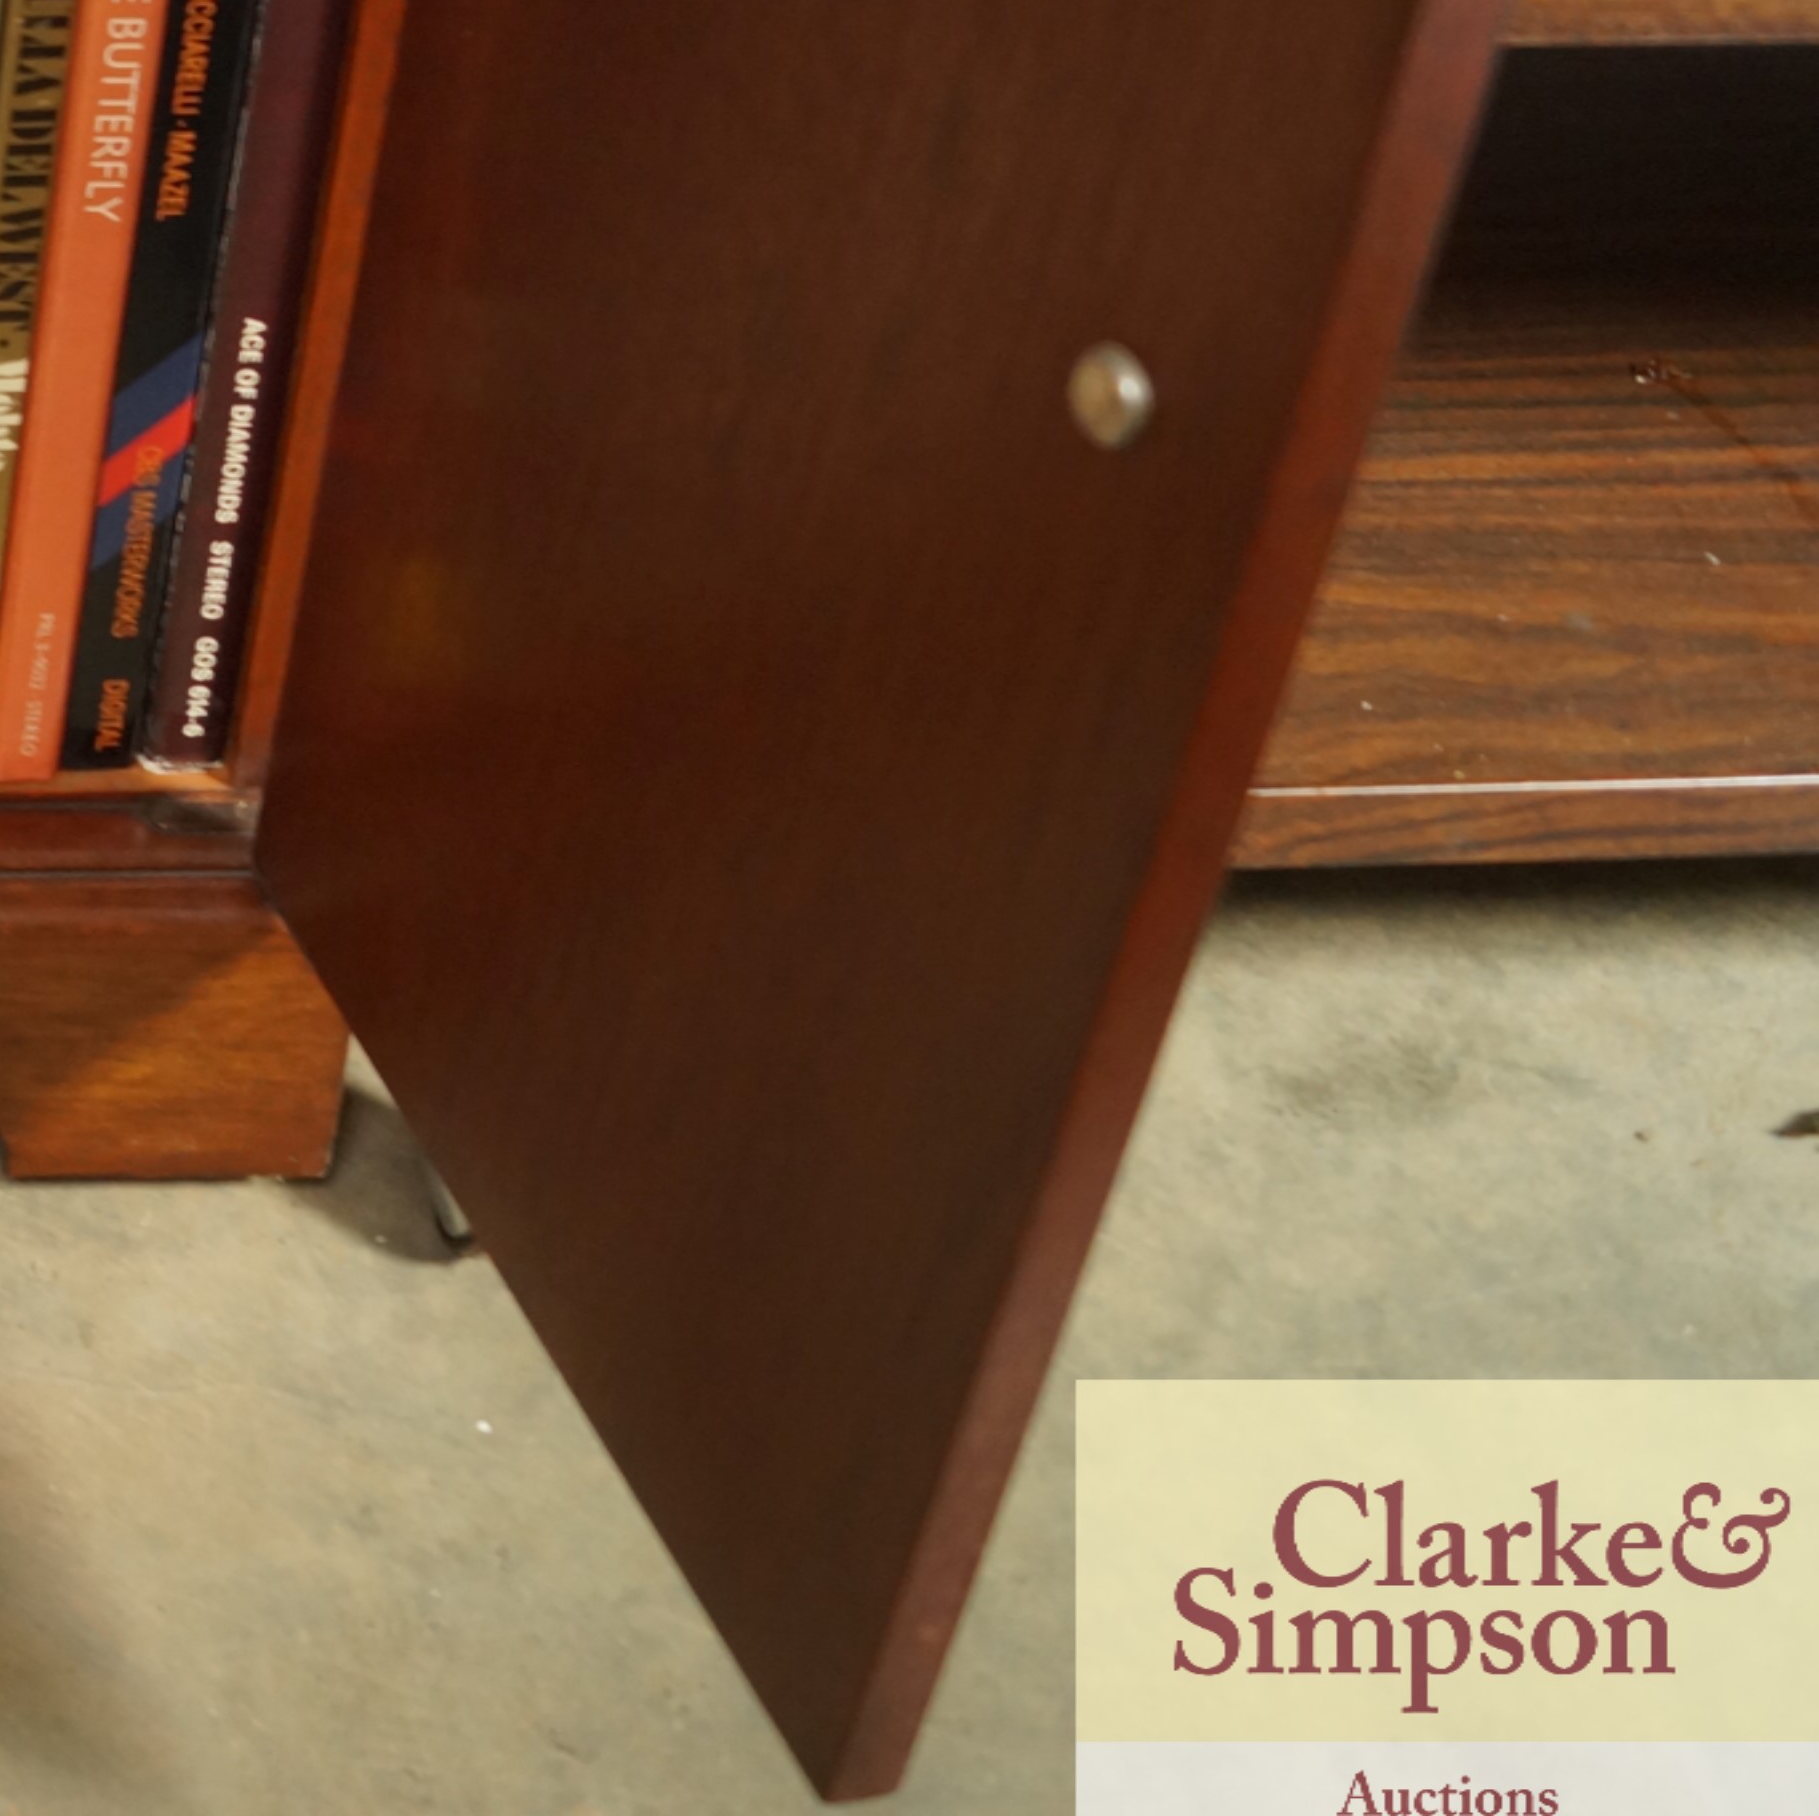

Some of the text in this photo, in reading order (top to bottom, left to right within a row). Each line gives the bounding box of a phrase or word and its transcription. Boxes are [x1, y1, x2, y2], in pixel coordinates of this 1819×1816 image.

[81, 17, 148, 223] BUTTERFLY
[156, 132, 197, 221] MAAZEL
[214, 317, 268, 523] ACE OF DIAMONDS
[112, 446, 166, 638] CBS MASTERWORKS
[19, 701, 45, 753] STEREO
[94, 679, 131, 750] DIGITAL
[182, 540, 235, 738] STEREO GOS 614-6
